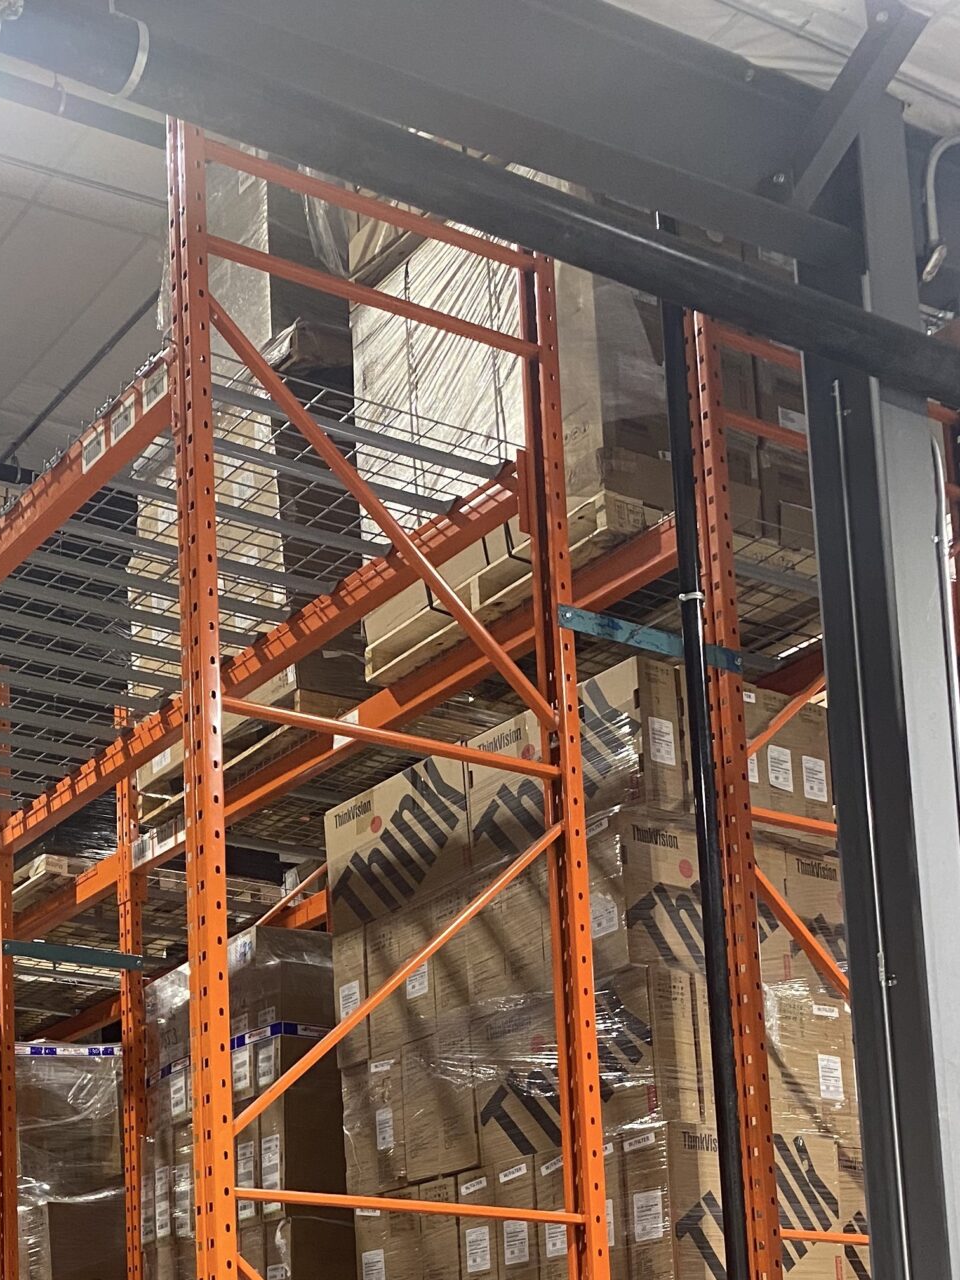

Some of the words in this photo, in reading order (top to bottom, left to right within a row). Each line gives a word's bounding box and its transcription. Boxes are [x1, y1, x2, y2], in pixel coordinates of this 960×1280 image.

[334, 800, 372, 829] ThinkVision
[331, 757, 467, 924] Think
[632, 823, 679, 850] ThinkVision
[796, 858, 838, 882] ThinkVision
[682, 1131, 718, 1152] ThinkVis
